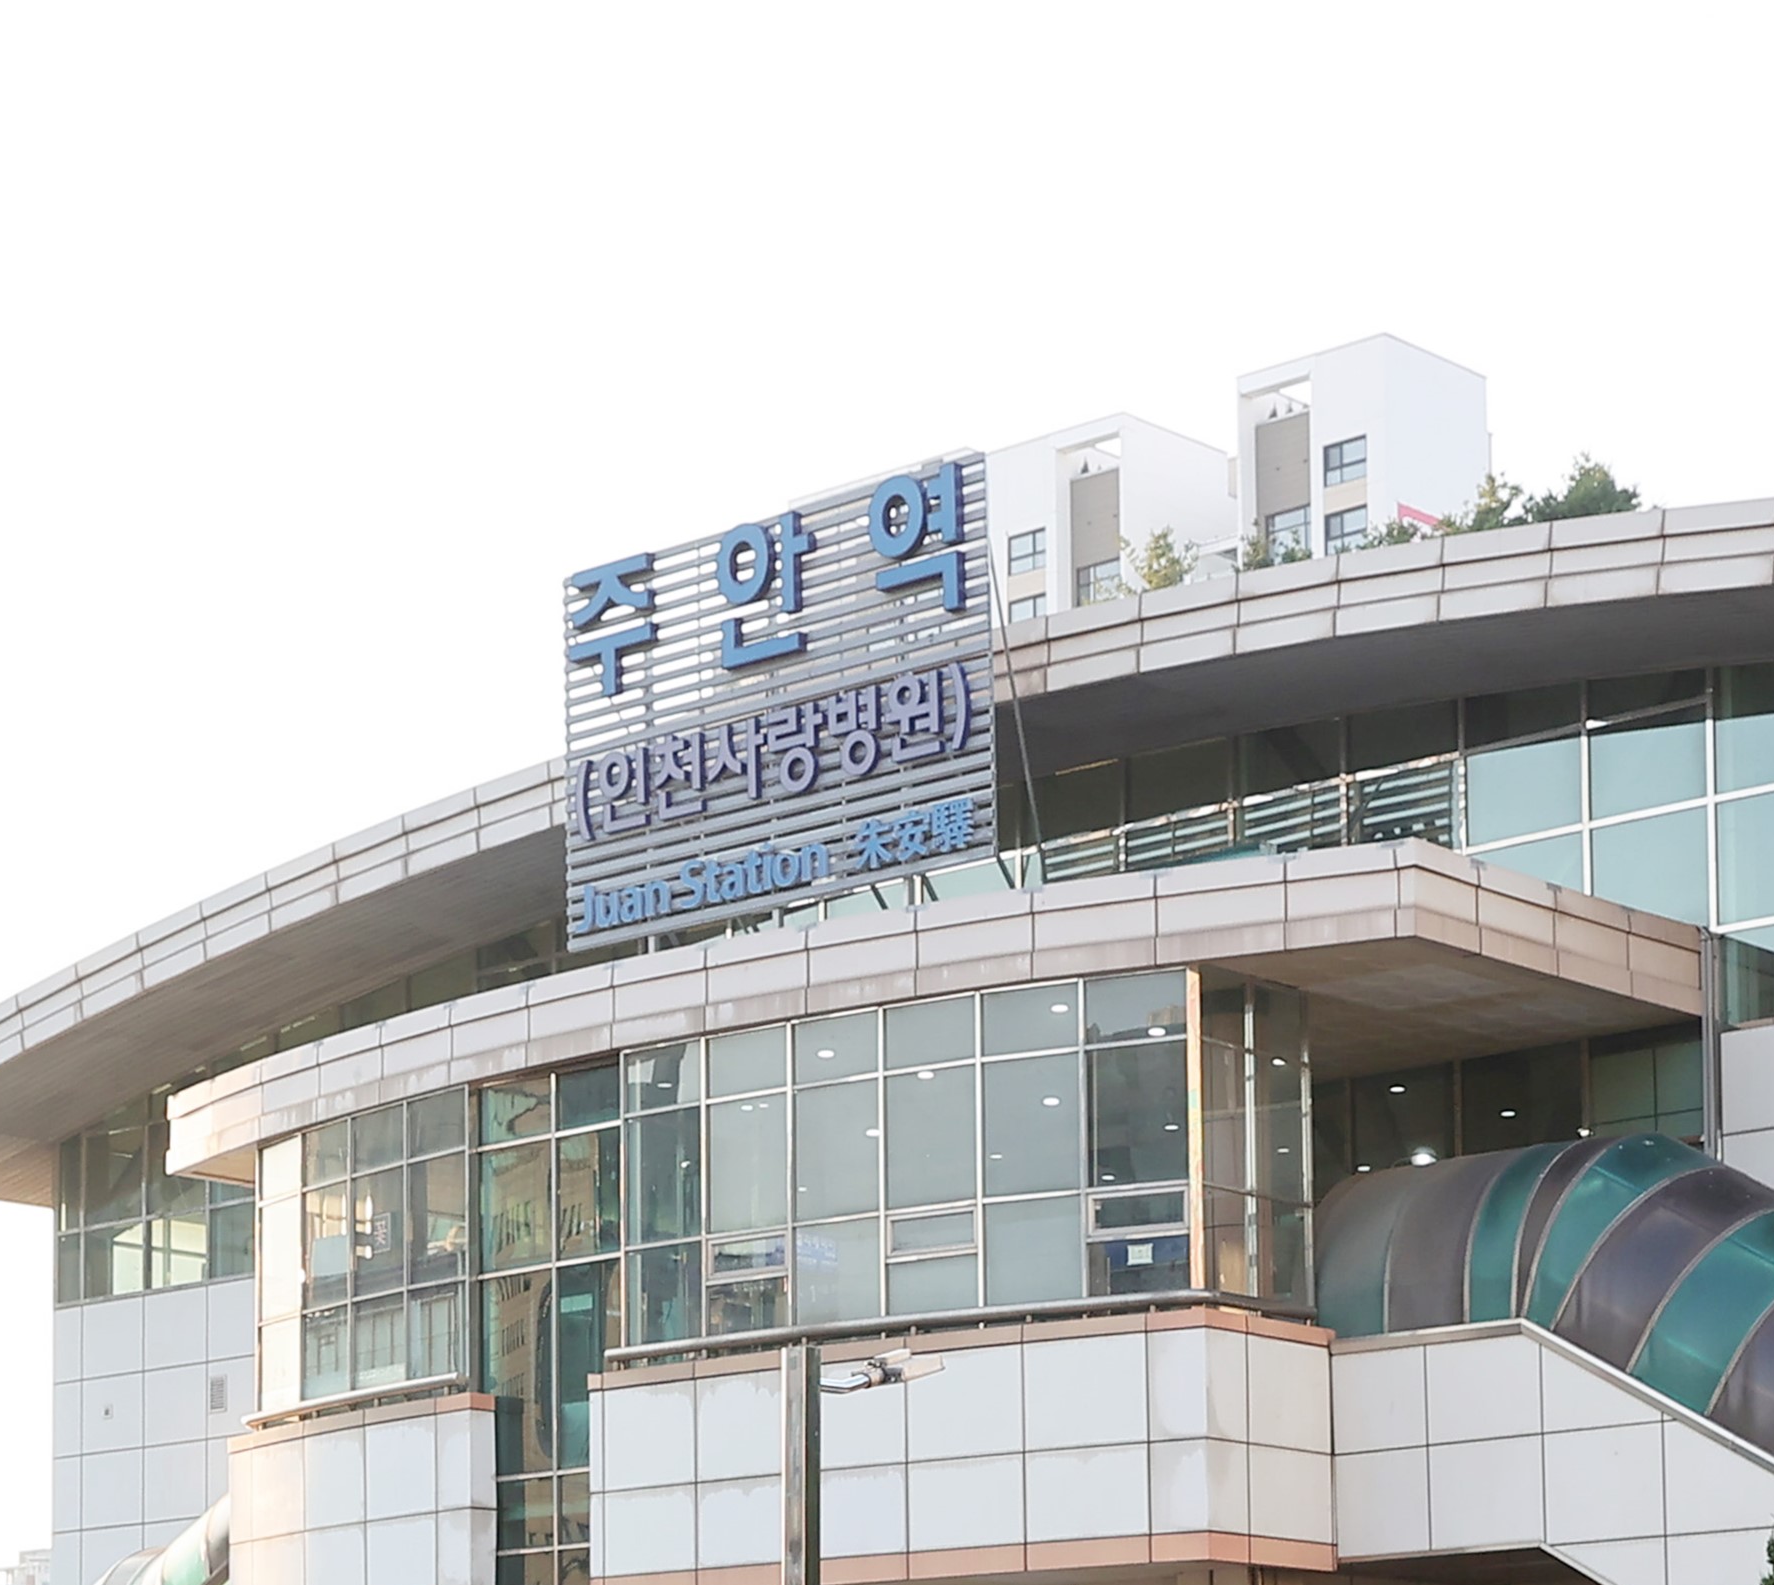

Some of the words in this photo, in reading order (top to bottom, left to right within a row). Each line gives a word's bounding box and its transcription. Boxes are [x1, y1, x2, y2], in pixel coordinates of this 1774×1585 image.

[568, 461, 967, 697] 주안역
[575, 662, 972, 840] (인천사랑병원)
[575, 876, 672, 933] Juan
[679, 842, 831, 910] Station
[855, 798, 975, 870] 朱安驛
